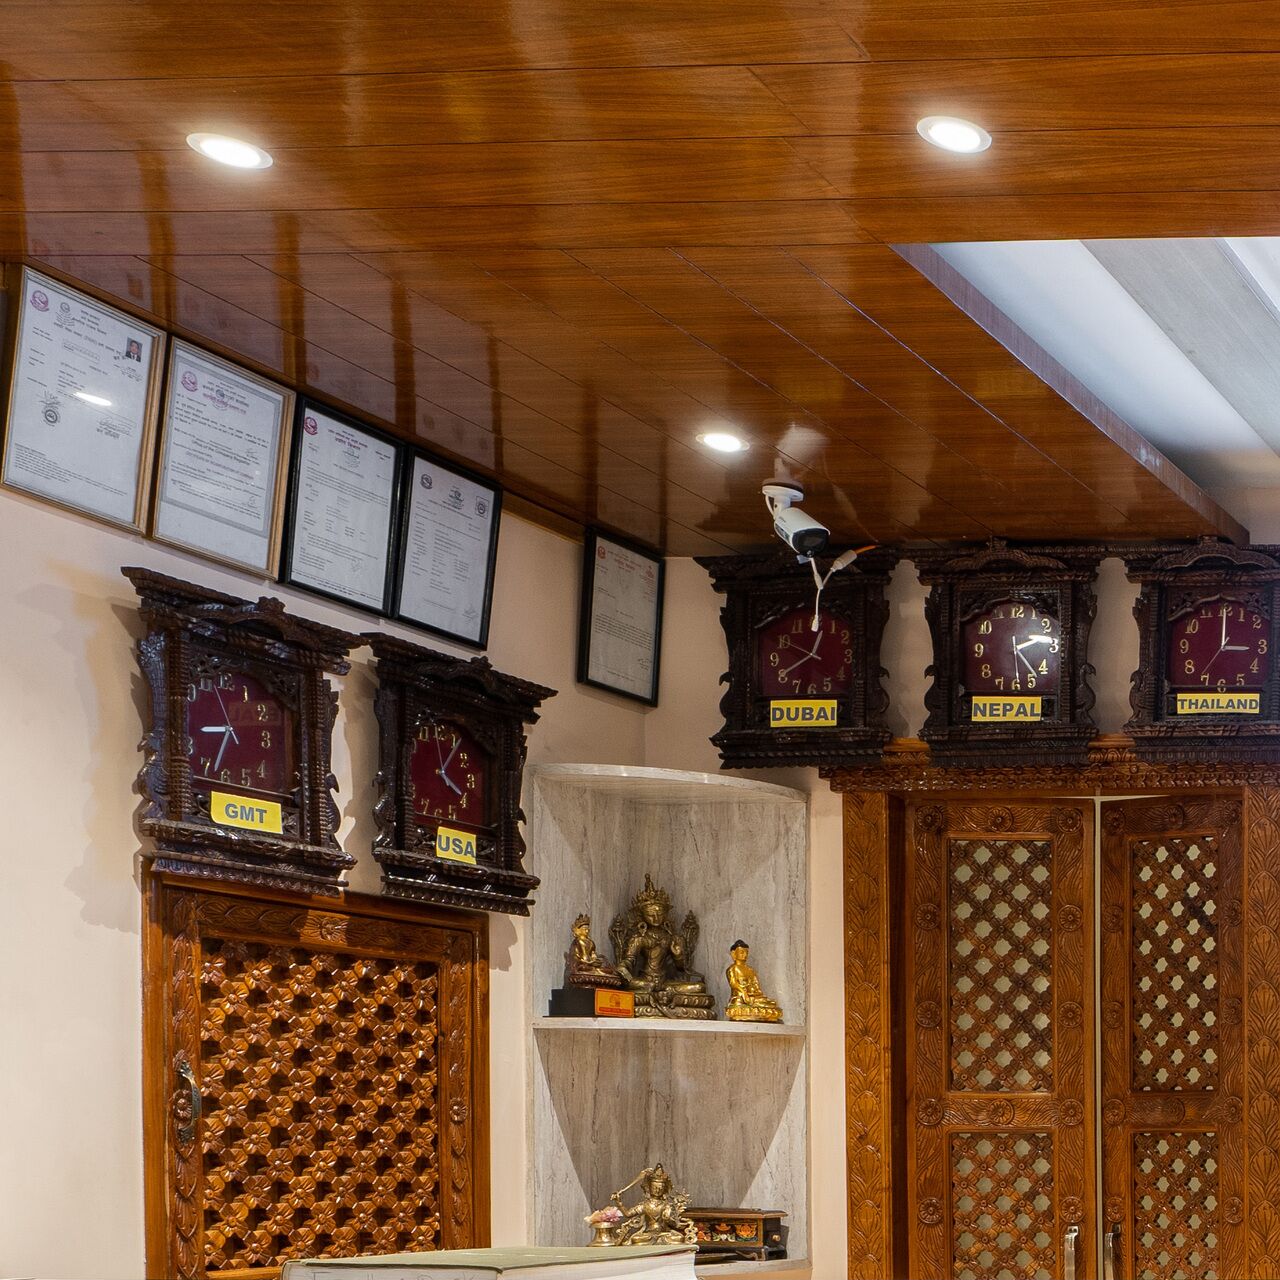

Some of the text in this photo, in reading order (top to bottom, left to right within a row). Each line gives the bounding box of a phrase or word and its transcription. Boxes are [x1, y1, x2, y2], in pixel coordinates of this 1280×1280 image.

[1010, 606, 1024, 618] 12
[1032, 607, 1037, 619] 1
[1238, 608, 1245, 621] 1
[791, 619, 803, 633] 11
[830, 620, 836, 633] 1
[979, 620, 992, 634] 10
[1041, 619, 1052, 633] 2
[1185, 619, 1198, 633] 10
[1252, 615, 1262, 629] 2
[778, 634, 790, 648] 10
[841, 630, 849, 644] 2
[975, 643, 984, 658] 9
[1049, 638, 1059, 653] 3
[1180, 639, 1189, 653] 9
[1258, 639, 1267, 654] 3
[770, 652, 779, 666] 9
[844, 649, 852, 663] 3
[982, 664, 991, 678] 8
[1039, 659, 1048, 674] 4
[1185, 660, 1195, 674] 8
[1250, 658, 1259, 673] 4
[778, 669, 787, 683] 8
[837, 666, 845, 680] 4
[1201, 673, 1209, 686] 7
[1236, 674, 1245, 686] 5
[792, 679, 801, 694] 7
[823, 678, 831, 692] 5
[995, 677, 1004, 690] 7
[1028, 673, 1036, 688] 5
[1217, 679, 1226, 693] 6
[243, 685, 248, 702] 1
[808, 684, 816, 697] 6
[972, 703, 1040, 718] NEPAL
[1178, 698, 1259, 710] THAILAND
[258, 704, 268, 721] 2
[771, 706, 837, 721] DUBAI
[262, 731, 270, 748] 3
[201, 757, 210, 776] 7
[460, 753, 469, 768] 2
[257, 760, 265, 778] 4
[242, 768, 250, 786] 5
[467, 774, 475, 788] 3
[421, 798, 429, 815] 7
[460, 793, 467, 808] 4
[225, 802, 267, 824] GMT
[437, 834, 476, 858] USA
